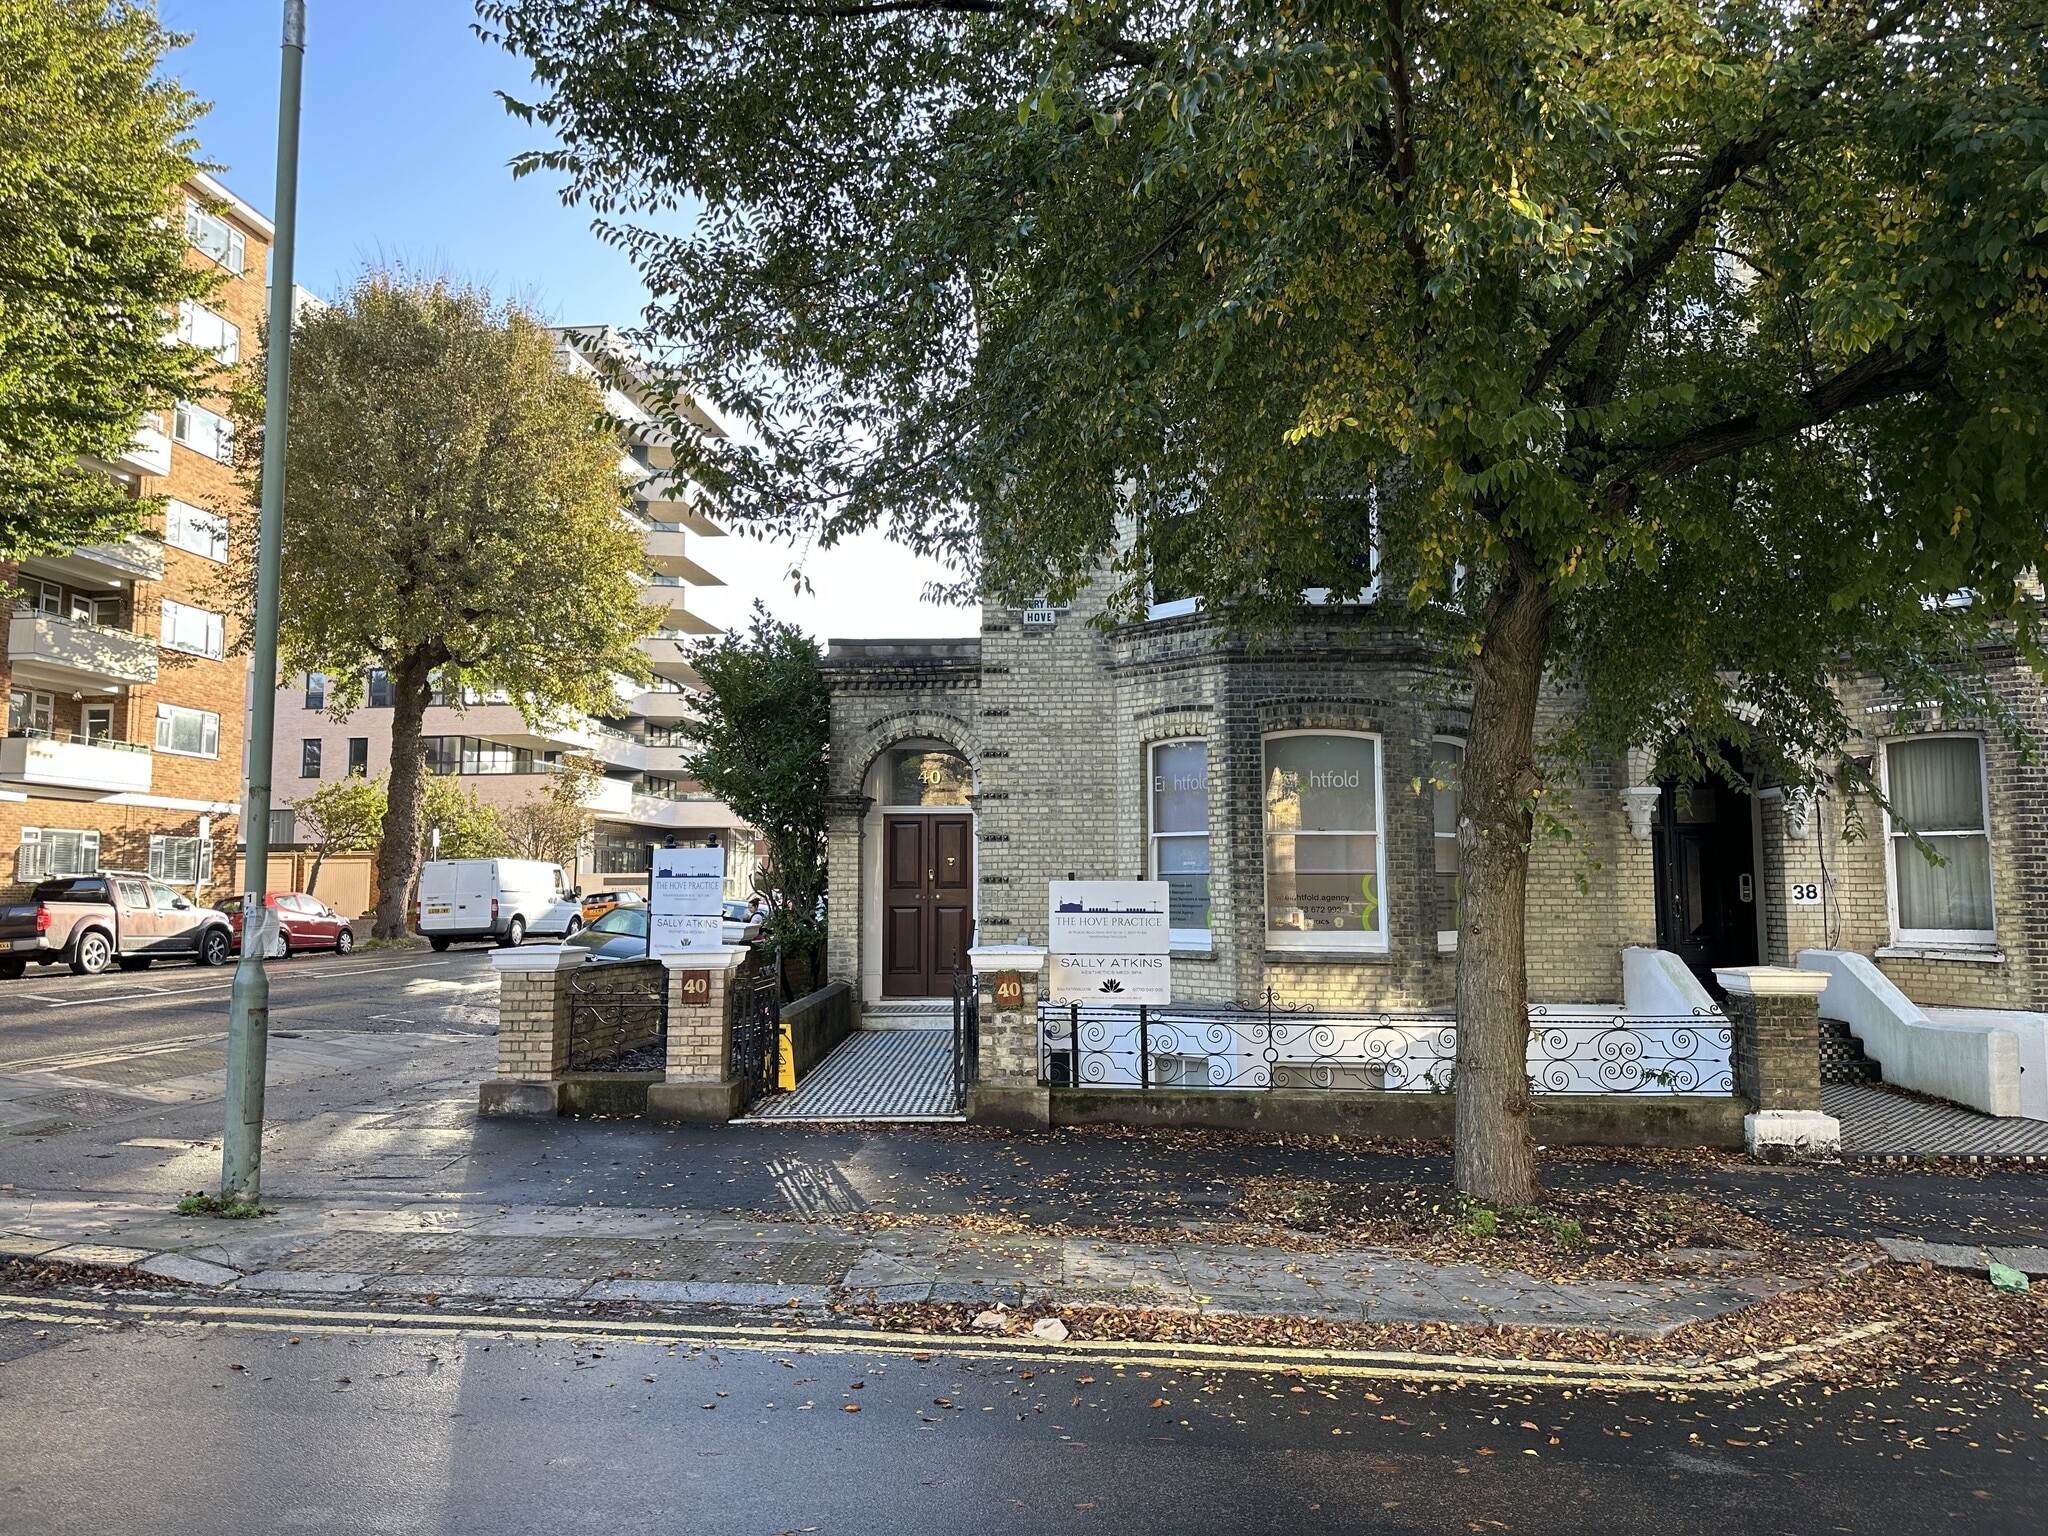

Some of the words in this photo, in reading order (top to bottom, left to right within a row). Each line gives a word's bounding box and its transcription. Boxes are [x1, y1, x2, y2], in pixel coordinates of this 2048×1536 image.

[1027, 612, 1052, 622] HOVE
[917, 770, 942, 785] 40
[656, 881, 668, 890] THE
[669, 881, 687, 890] HOVE
[688, 881, 719, 890] PRACTICE
[1793, 884, 1818, 900] 38
[247, 893, 253, 903] 1
[656, 918, 684, 928] SALLY
[685, 919, 719, 929] ATKINS
[1056, 916, 1077, 927] THE
[1079, 916, 1109, 927] HOVE
[1111, 916, 1162, 927] PRACTICE
[1060, 957, 1106, 968] SALLY
[1110, 957, 1163, 968] ATKINS
[683, 978, 707, 994] 40
[997, 982, 1021, 998] 40
